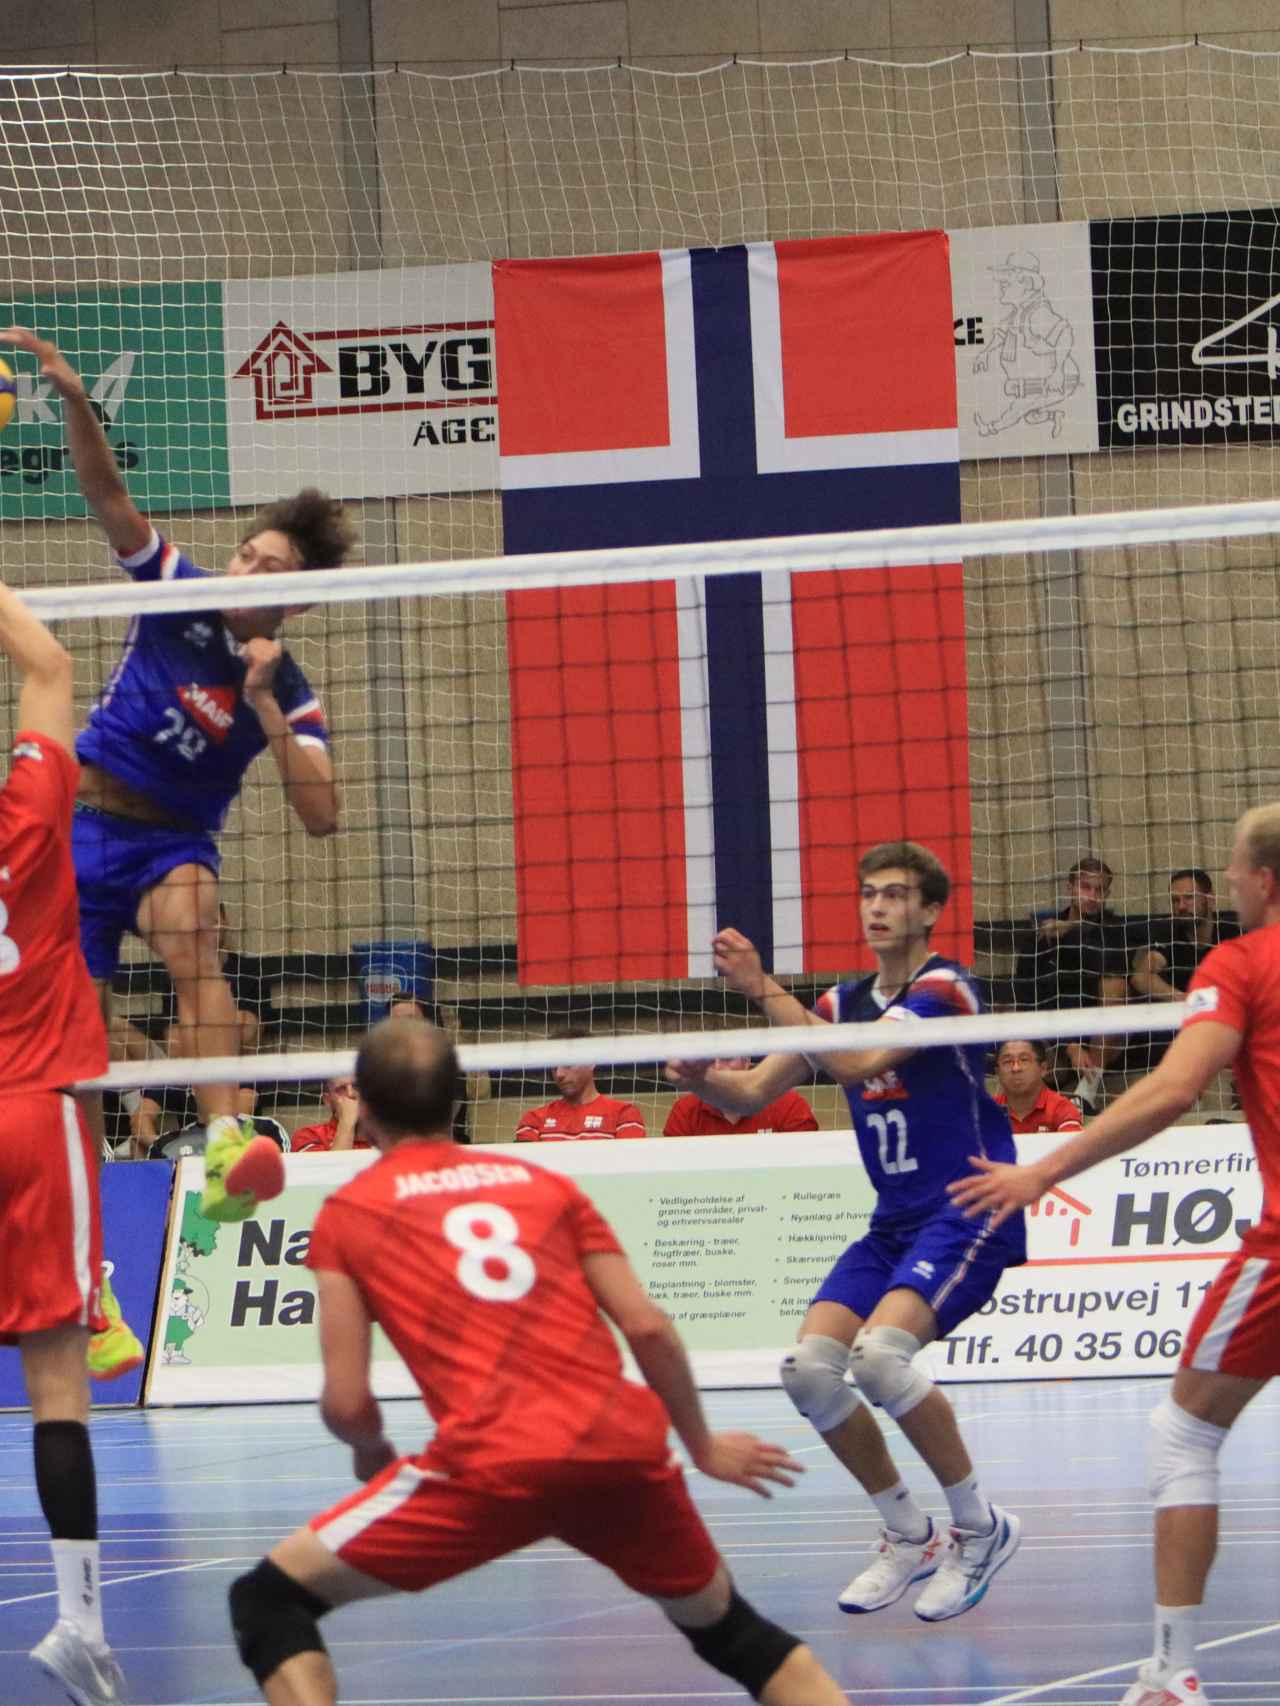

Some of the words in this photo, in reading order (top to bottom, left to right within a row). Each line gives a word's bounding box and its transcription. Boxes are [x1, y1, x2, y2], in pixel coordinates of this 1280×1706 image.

[338, 337, 492, 399] BYG
[866, 1108, 918, 1175] 22
[395, 1163, 532, 1199] JACOBSEN
[1120, 1153, 1261, 1177] Tømrerfir
[658, 1207, 691, 1217] grønne
[660, 1196, 733, 1206] Vedligeholdelse
[657, 1219, 669, 1227] og
[442, 1201, 537, 1302] 8
[944, 1336, 1000, 1366] Tlf.
[1015, 1333, 1063, 1363] 40
[1074, 1331, 1122, 1361] 35
[1134, 1329, 1182, 1359] 06
